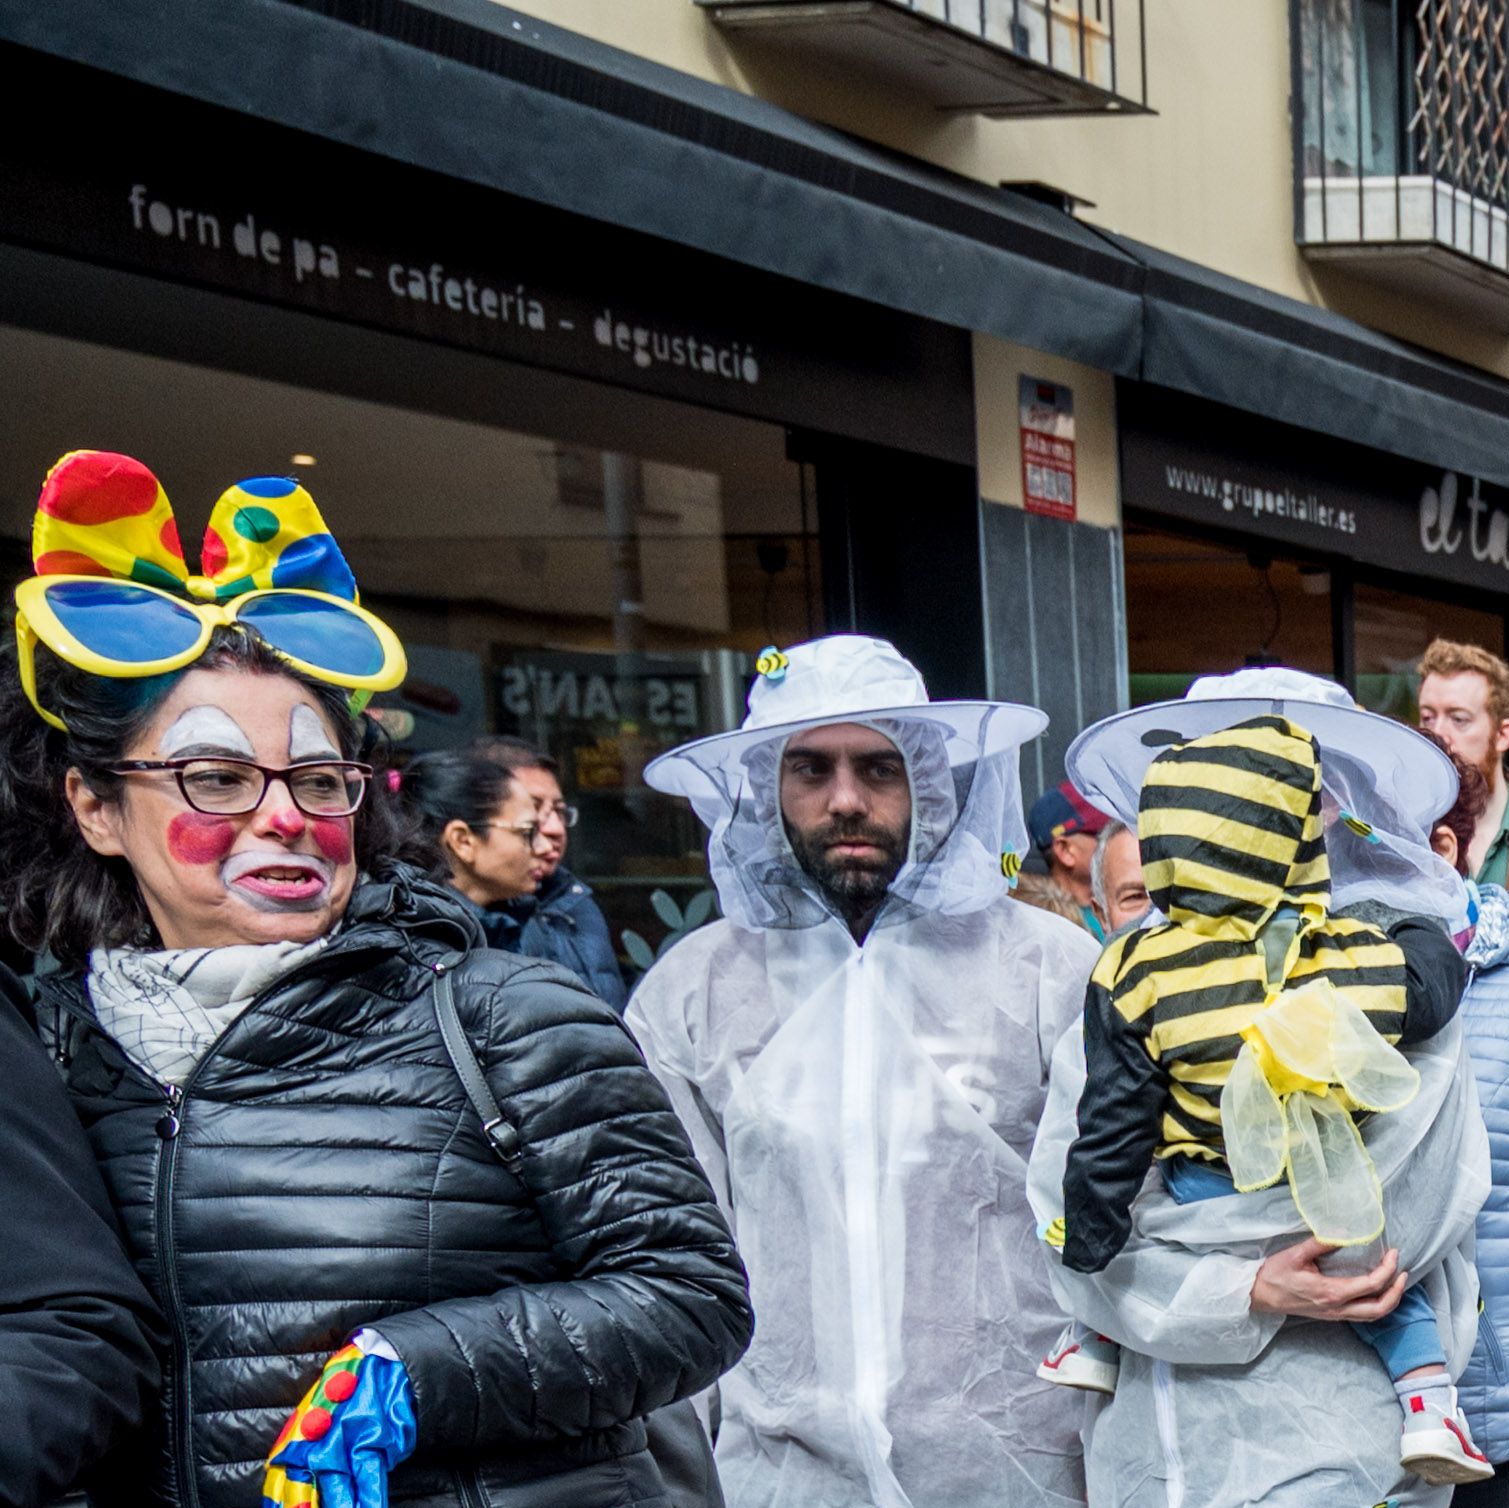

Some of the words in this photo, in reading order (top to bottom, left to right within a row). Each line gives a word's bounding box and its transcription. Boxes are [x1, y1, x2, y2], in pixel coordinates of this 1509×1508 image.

[128, 183, 221, 249] forn
[233, 213, 281, 265] de
[292, 236, 339, 281] pa
[593, 308, 759, 384] degustació
[1419, 472, 1463, 553] el
